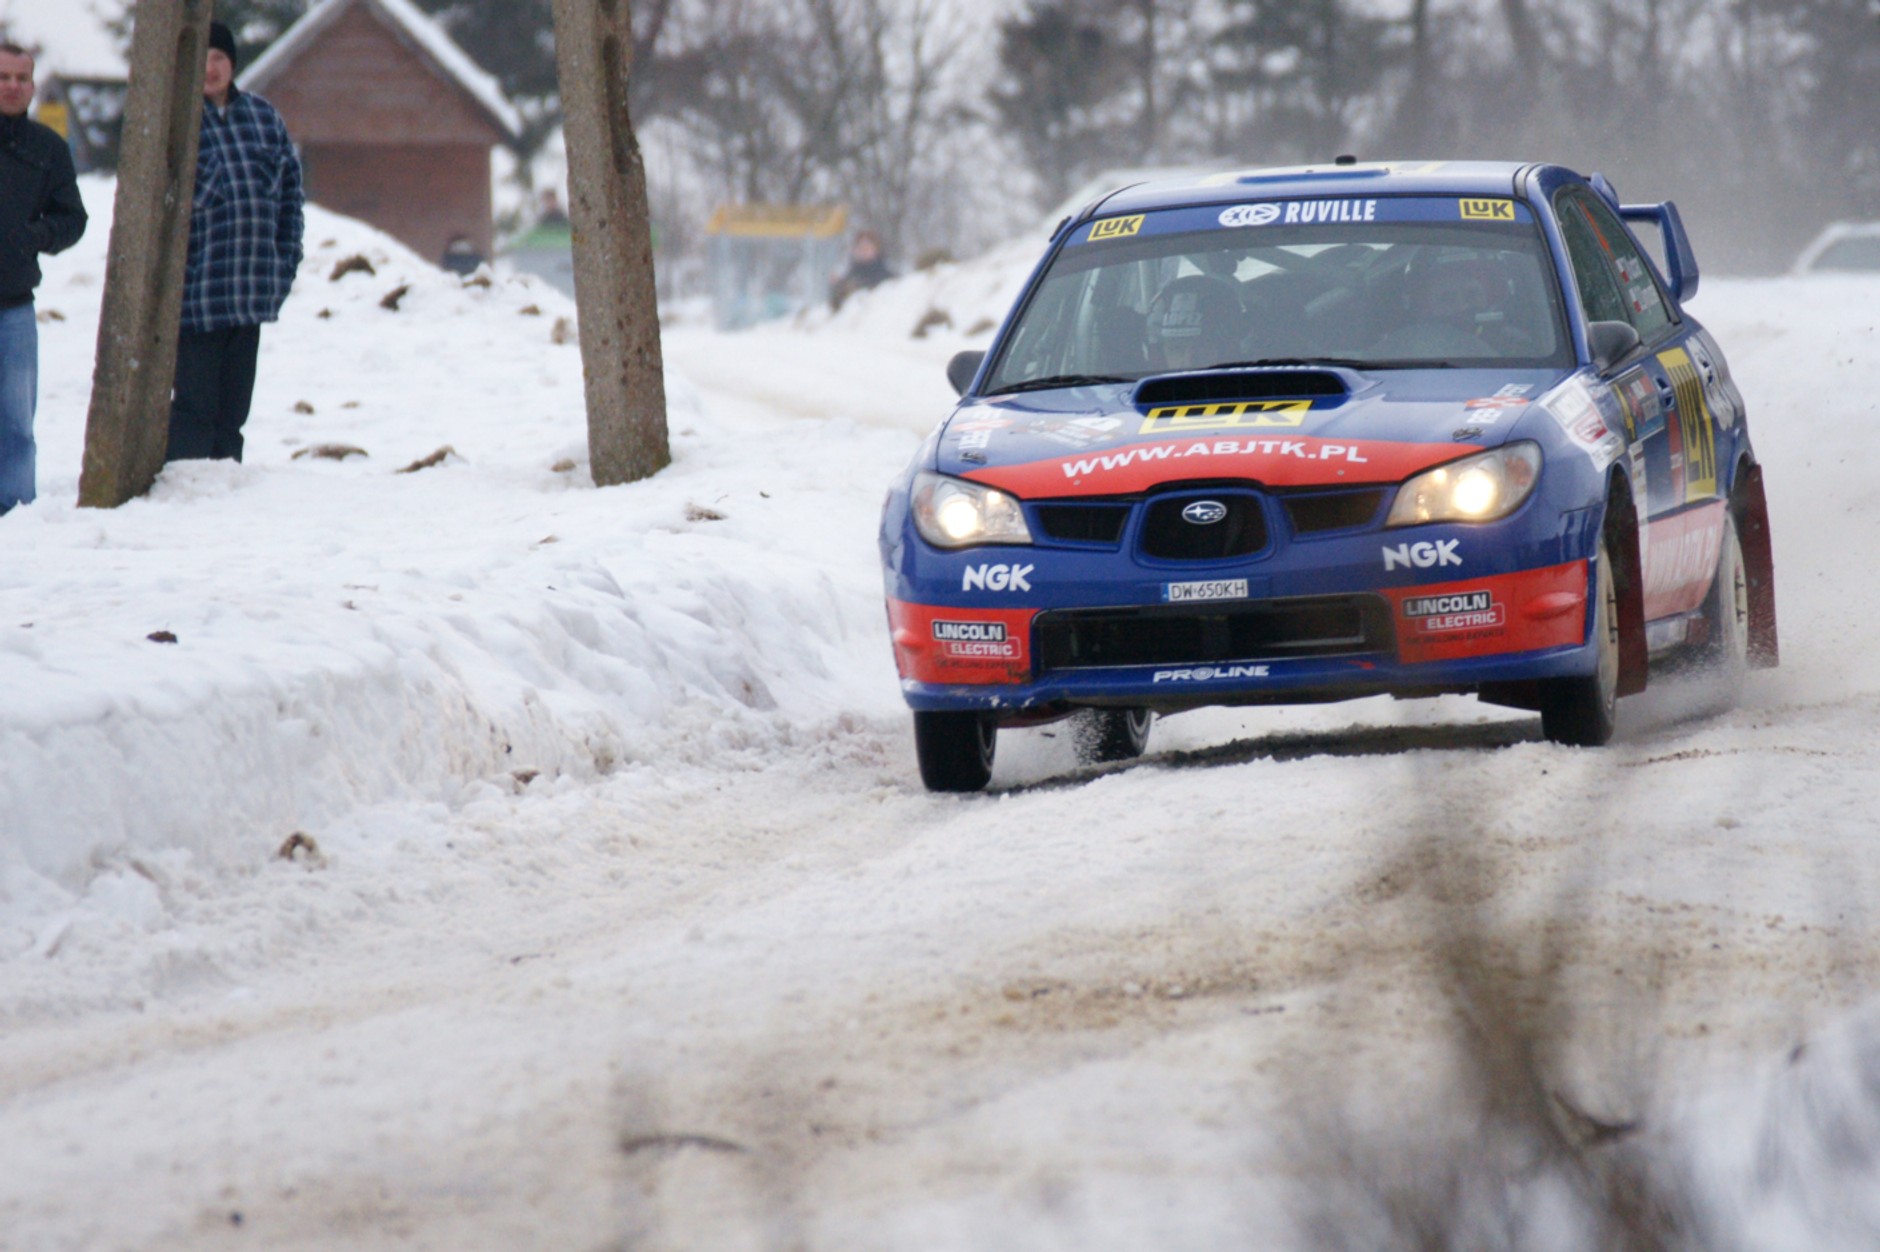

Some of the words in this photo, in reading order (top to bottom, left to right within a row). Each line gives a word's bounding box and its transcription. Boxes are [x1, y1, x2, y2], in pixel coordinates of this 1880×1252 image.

[1285, 200, 1377, 223] RUVILLE
[1062, 440, 1368, 478] WWW.ABJTK.PL
[1381, 538, 1463, 571] NGK
[962, 563, 1035, 592] NGK
[1406, 594, 1487, 616] LINCOLN
[934, 622, 1003, 640] LINCOLN
[1427, 611, 1497, 630] ELECTRIC
[951, 643, 1013, 656] ELECTRIC
